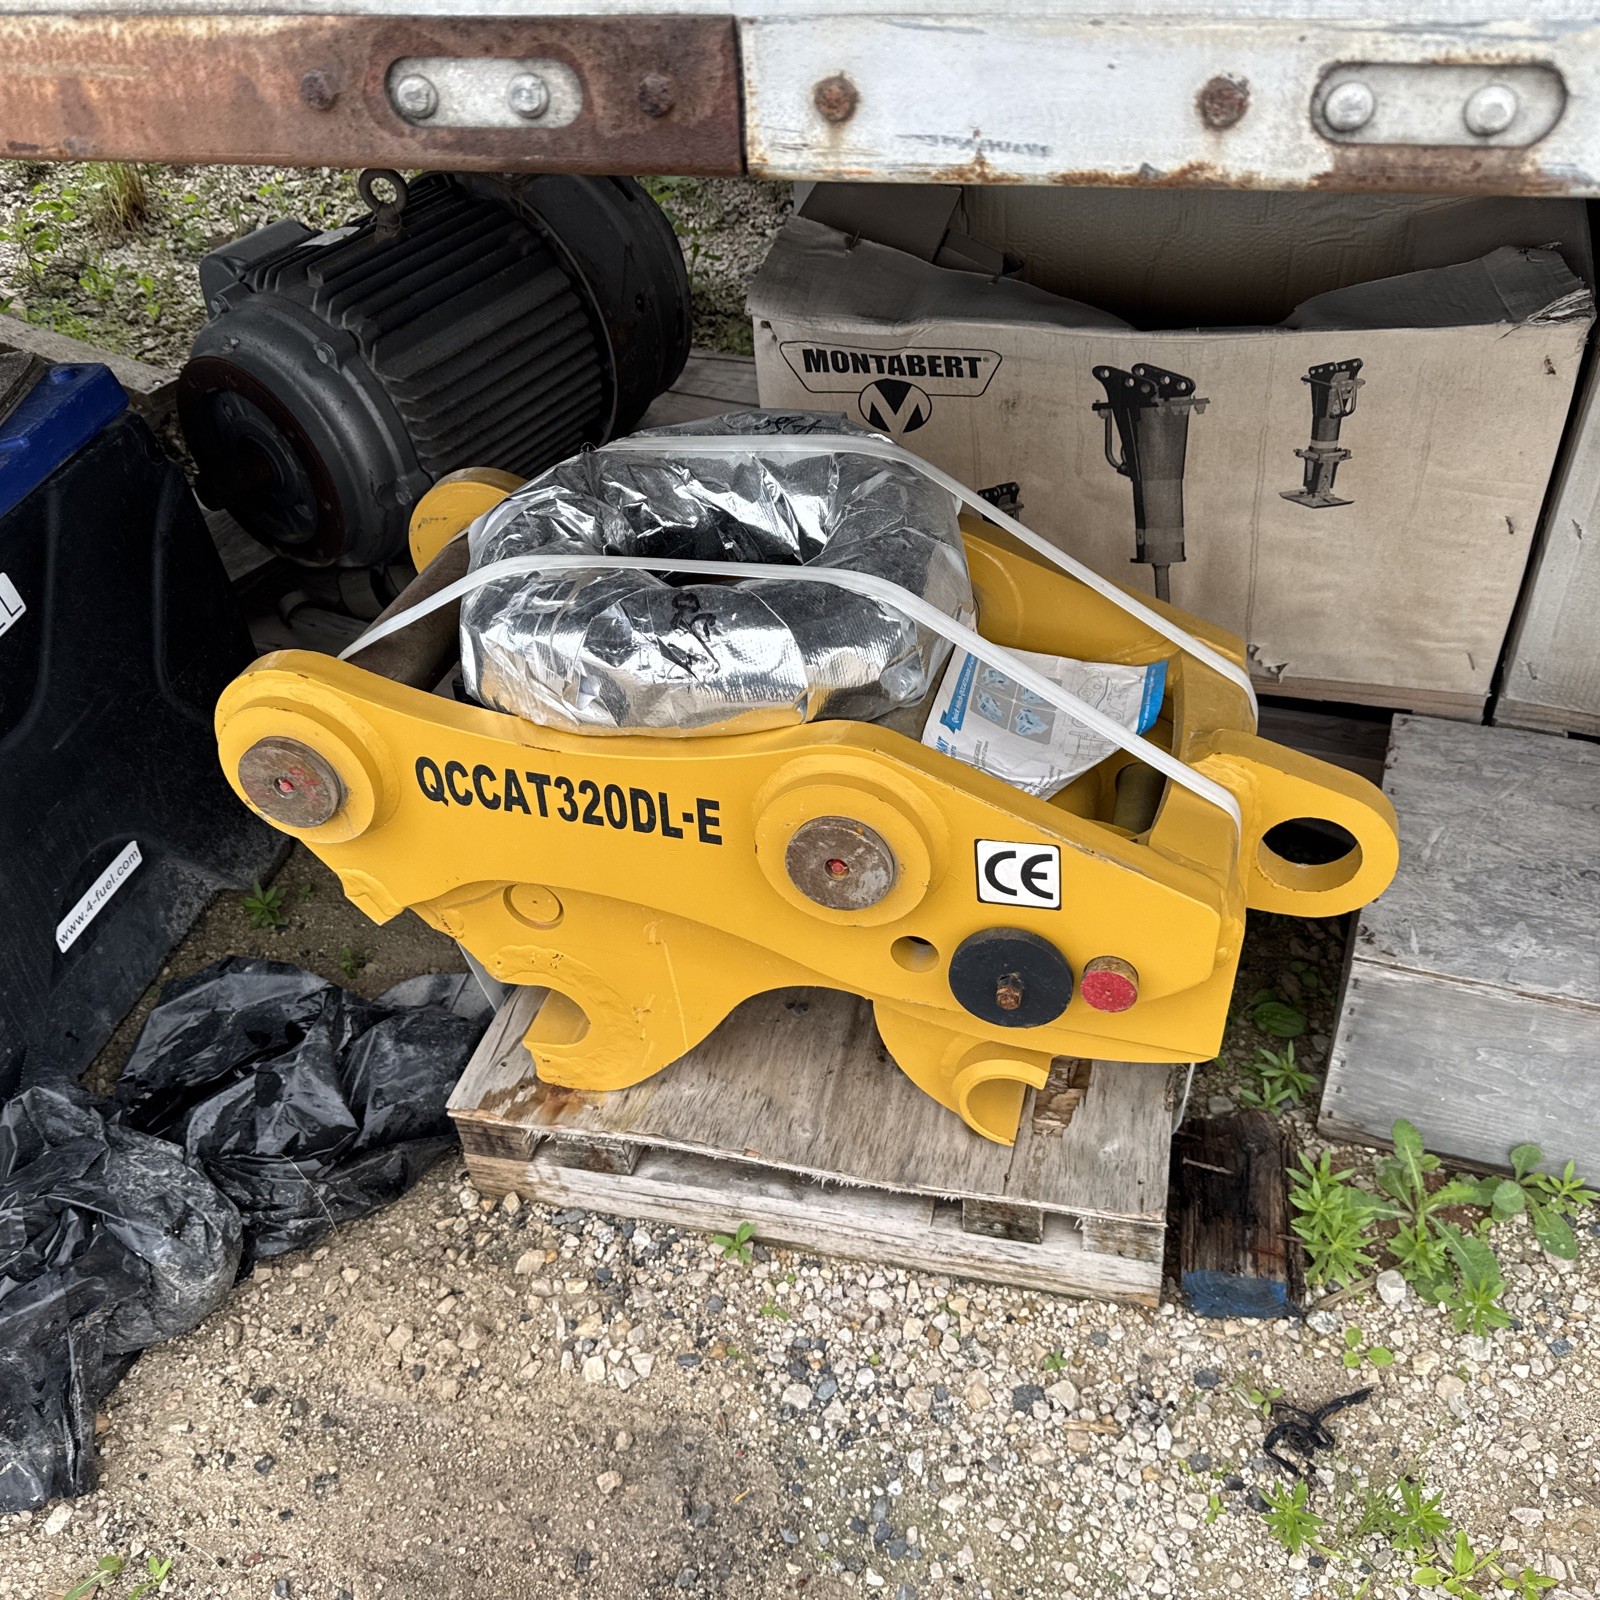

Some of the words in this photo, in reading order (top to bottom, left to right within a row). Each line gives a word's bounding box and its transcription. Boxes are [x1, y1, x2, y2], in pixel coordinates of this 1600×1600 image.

[801, 348, 982, 378] MONTABERT
[415, 756, 723, 845] QCCAT320DL-E
[59, 850, 139, 944] www.4-fuel.com
[984, 850, 1054, 900] CE
